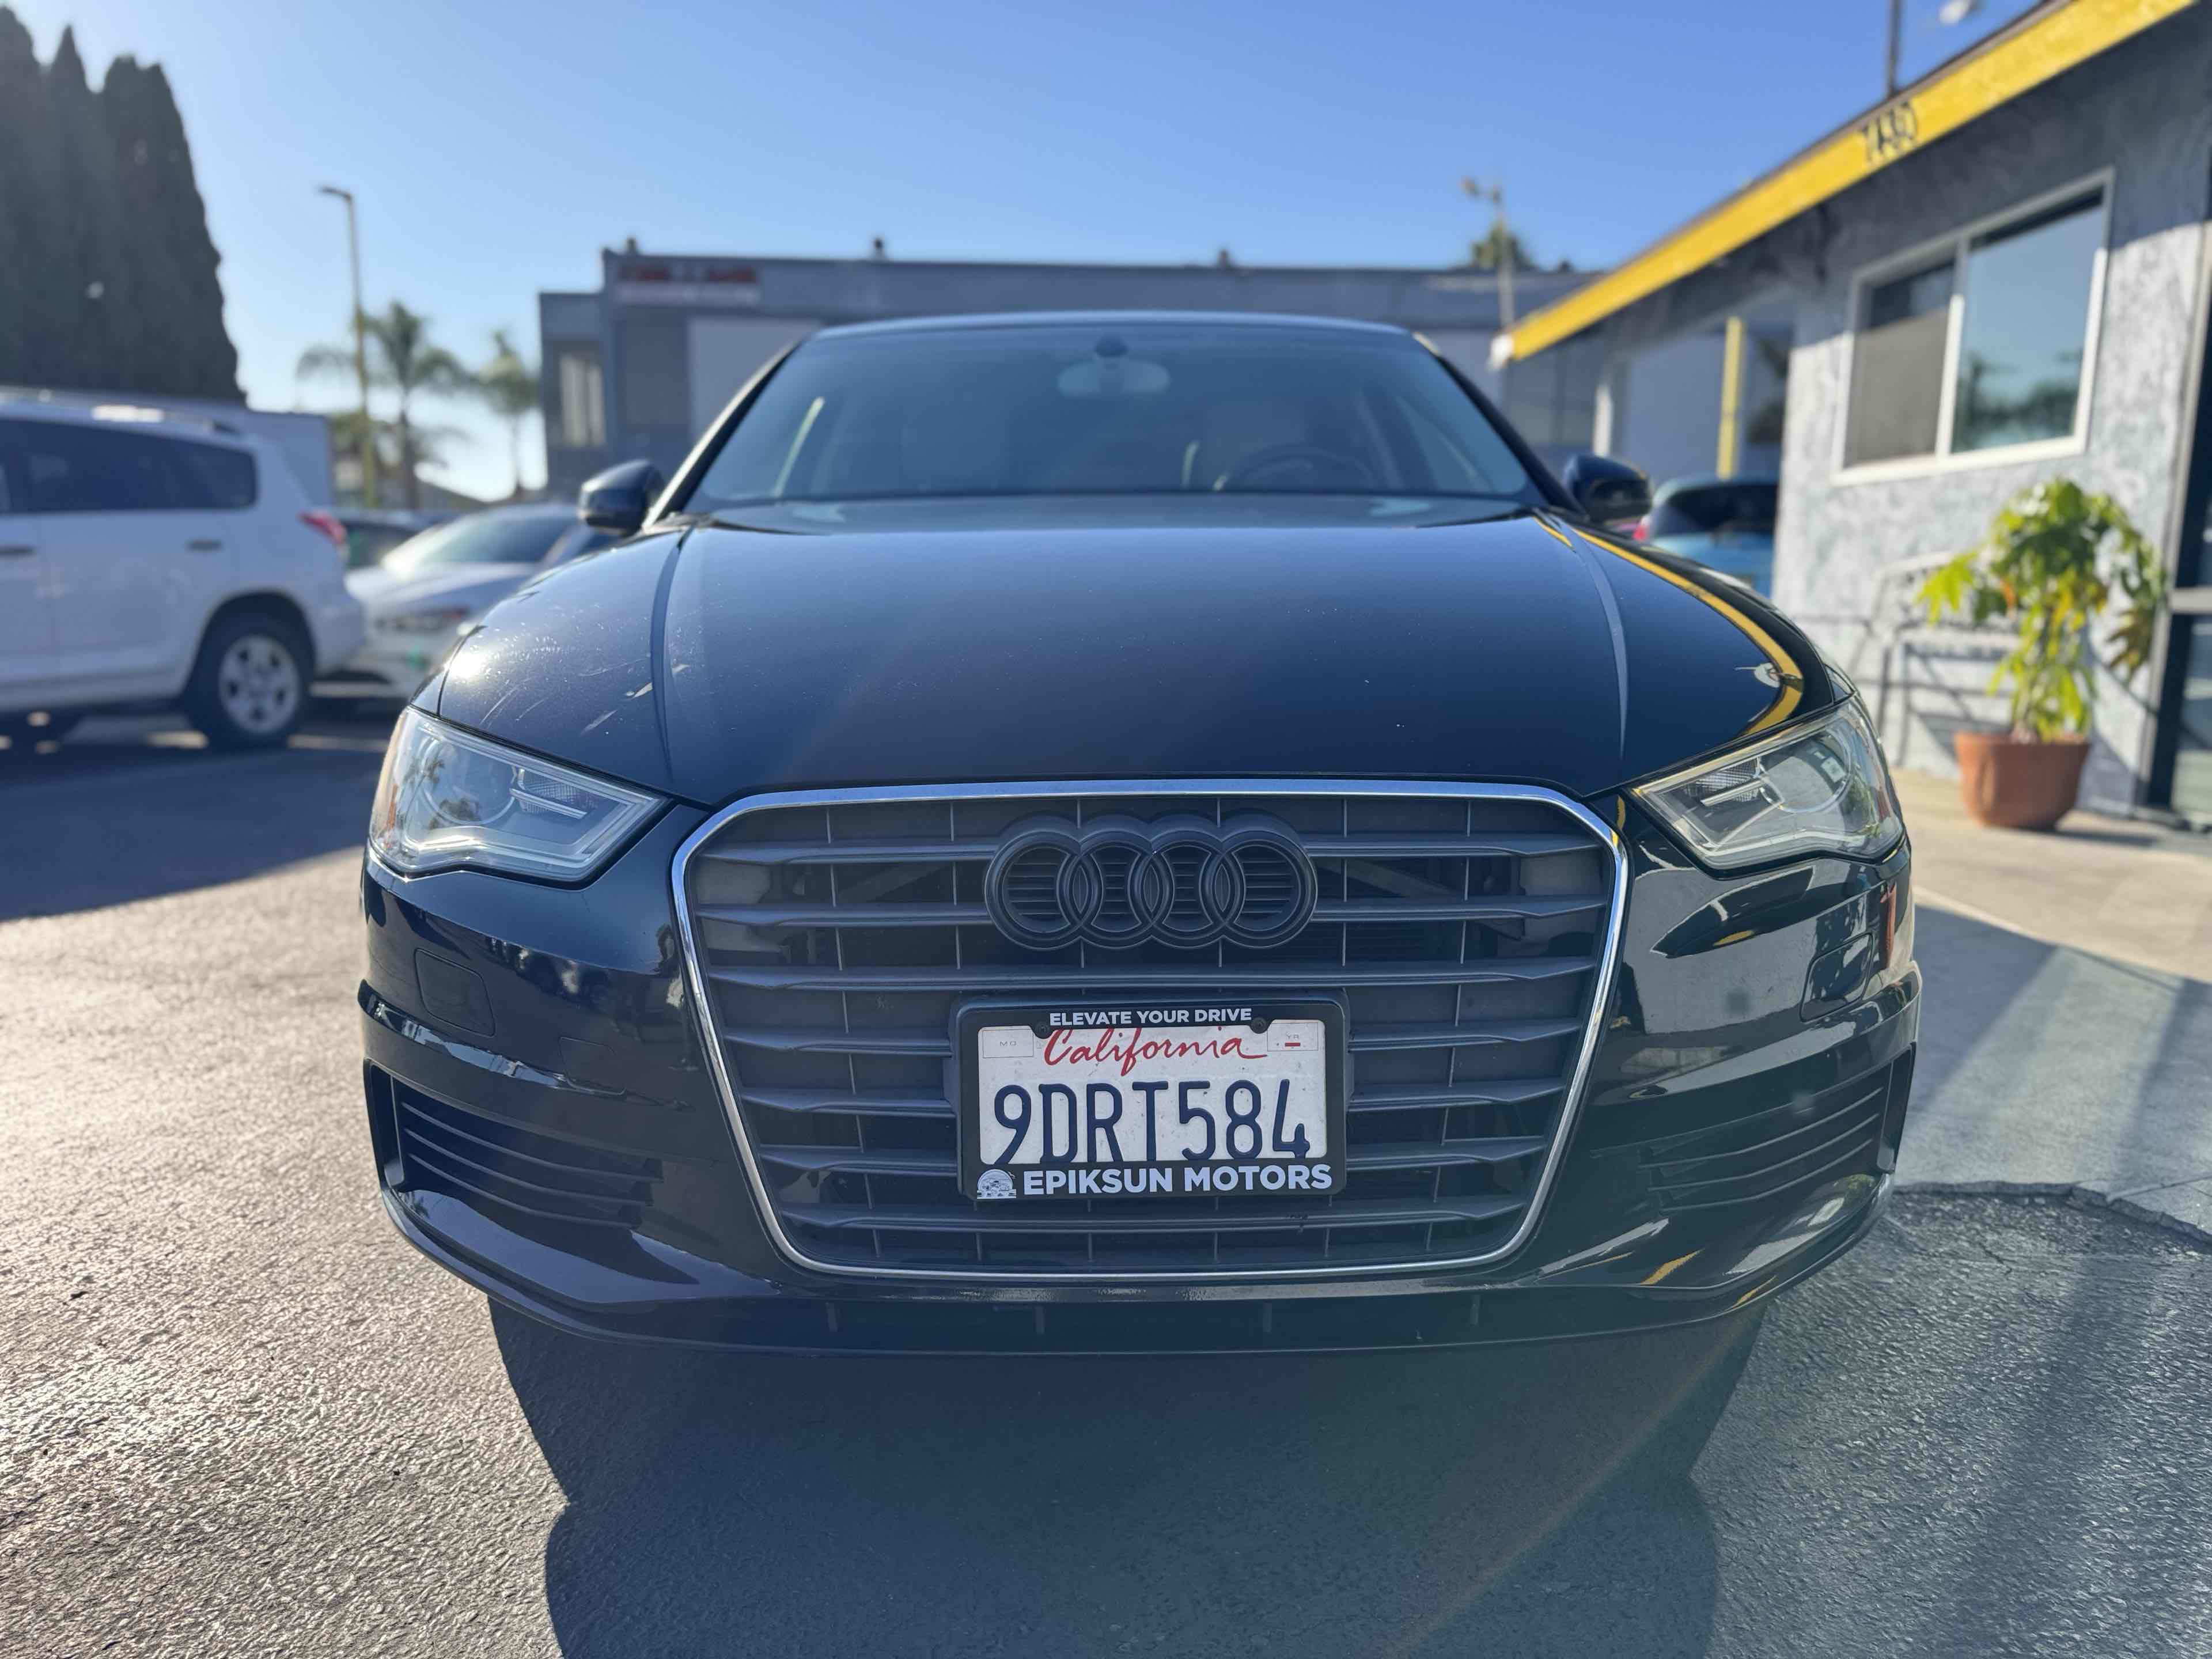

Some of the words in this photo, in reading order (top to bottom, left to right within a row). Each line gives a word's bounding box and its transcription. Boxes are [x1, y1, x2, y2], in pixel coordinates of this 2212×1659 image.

[1050, 1011, 1131, 1026] ELEVATE
[1137, 1010, 1190, 1024] YOUR
[1195, 1008, 1252, 1022] DRIVE
[1044, 1027, 1267, 1077] California
[993, 1079, 1310, 1165] 9DRT584
[1024, 1167, 1173, 1195] EPIKSUN
[1184, 1164, 1332, 1192] MOTORS
